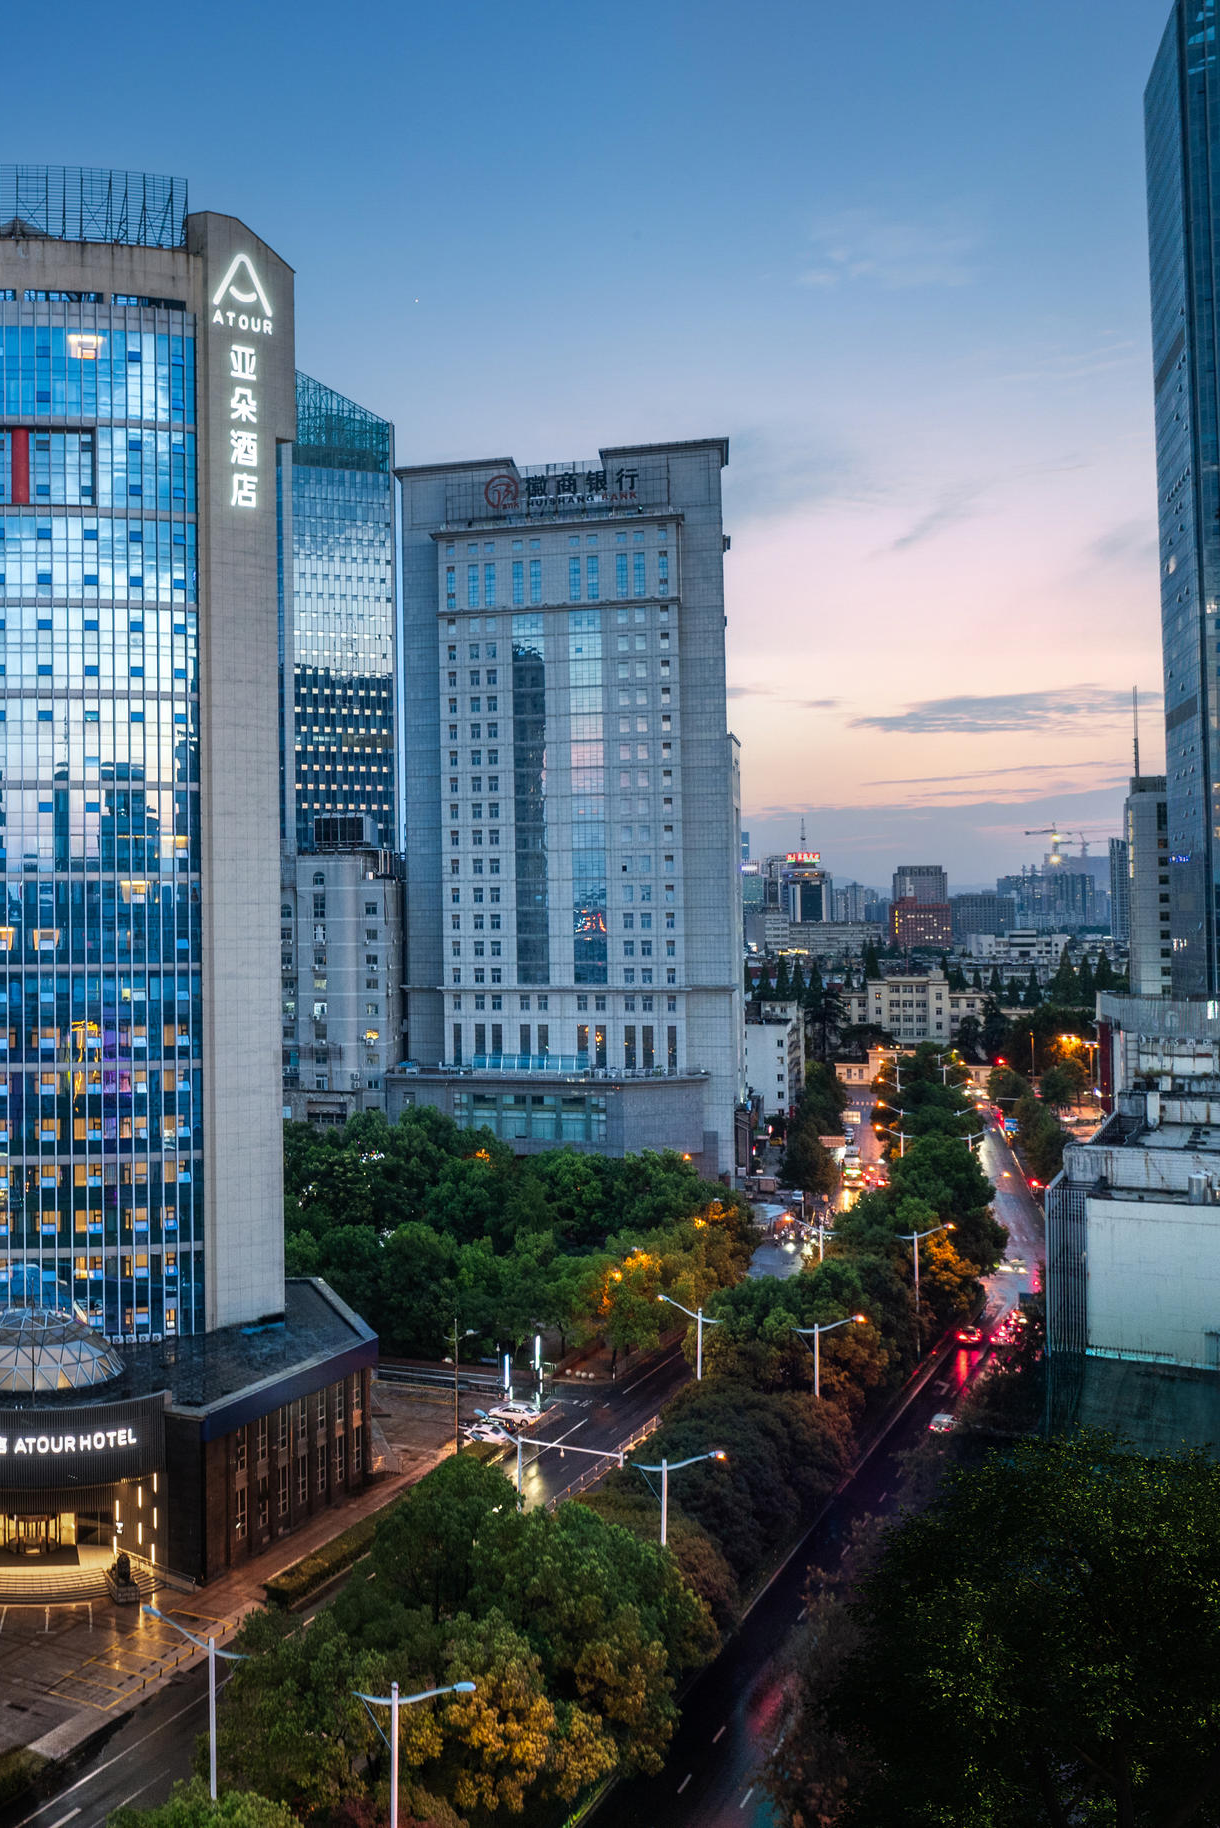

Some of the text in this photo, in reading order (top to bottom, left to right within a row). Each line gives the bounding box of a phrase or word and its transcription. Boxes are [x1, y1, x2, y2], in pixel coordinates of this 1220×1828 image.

[212, 308, 273, 336] ATOUR
[229, 343, 259, 509] 亚朵酒店
[525, 468, 639, 497] 徽商银行
[527, 490, 638, 508] HUISHANG BANK
[13, 1427, 137, 1455] ATOUR HOTEL
